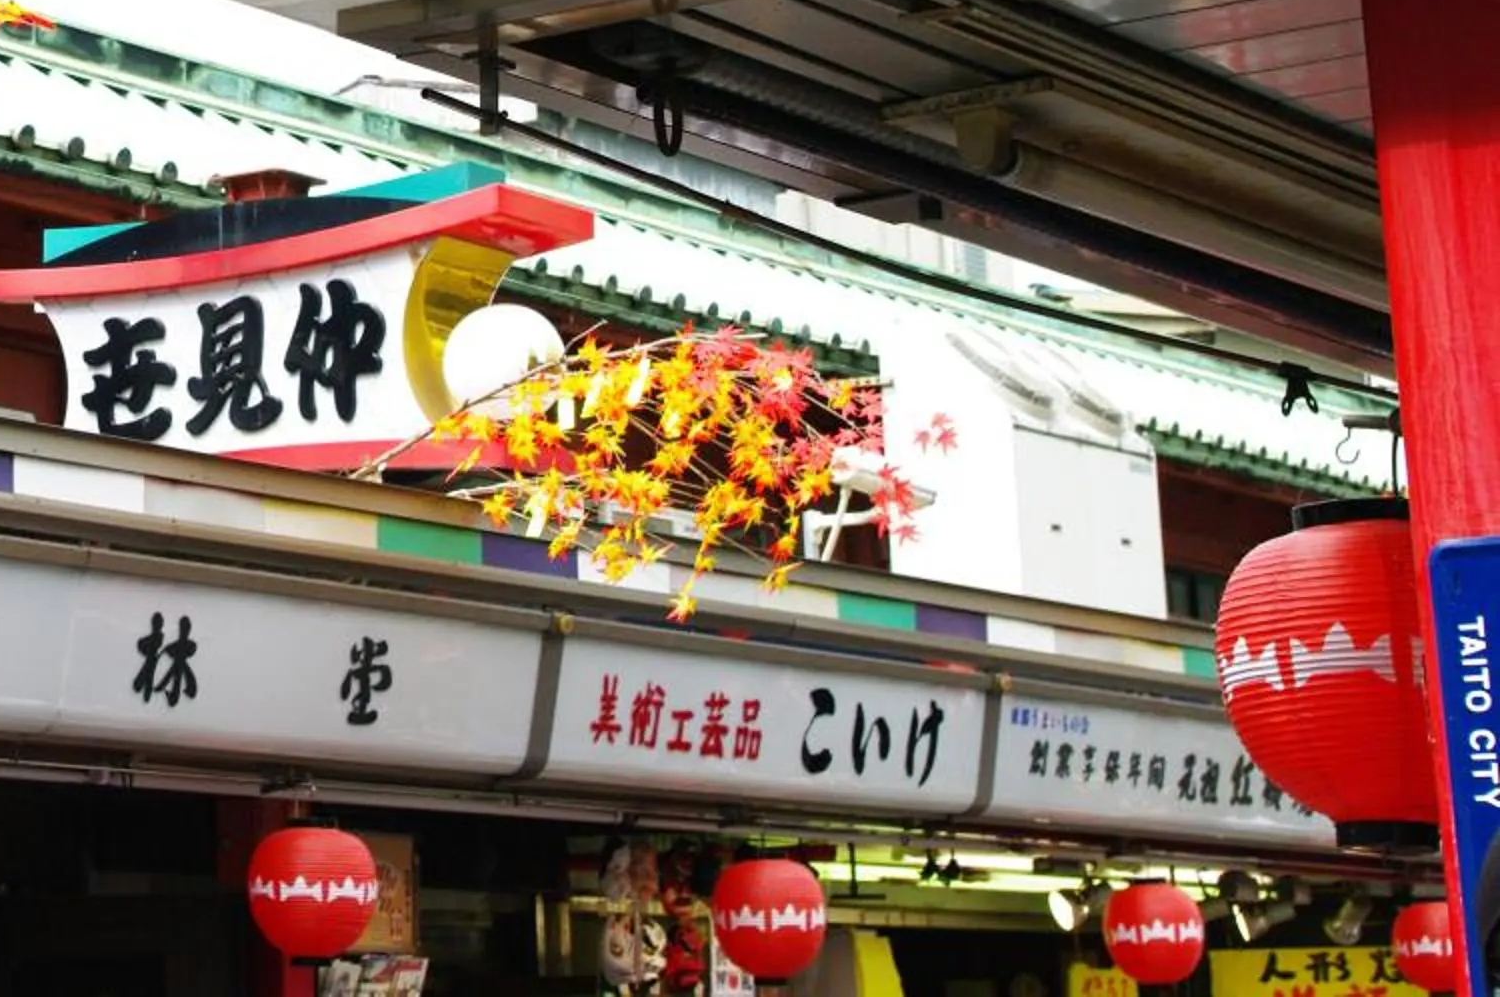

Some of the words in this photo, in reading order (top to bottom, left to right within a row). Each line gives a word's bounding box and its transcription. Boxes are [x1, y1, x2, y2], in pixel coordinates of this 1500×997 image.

[1457, 615, 1493, 713] TAITO
[589, 674, 764, 761] 美術工芸品
[801, 688, 944, 787] こいけ
[1469, 729, 1500, 808] CITY
